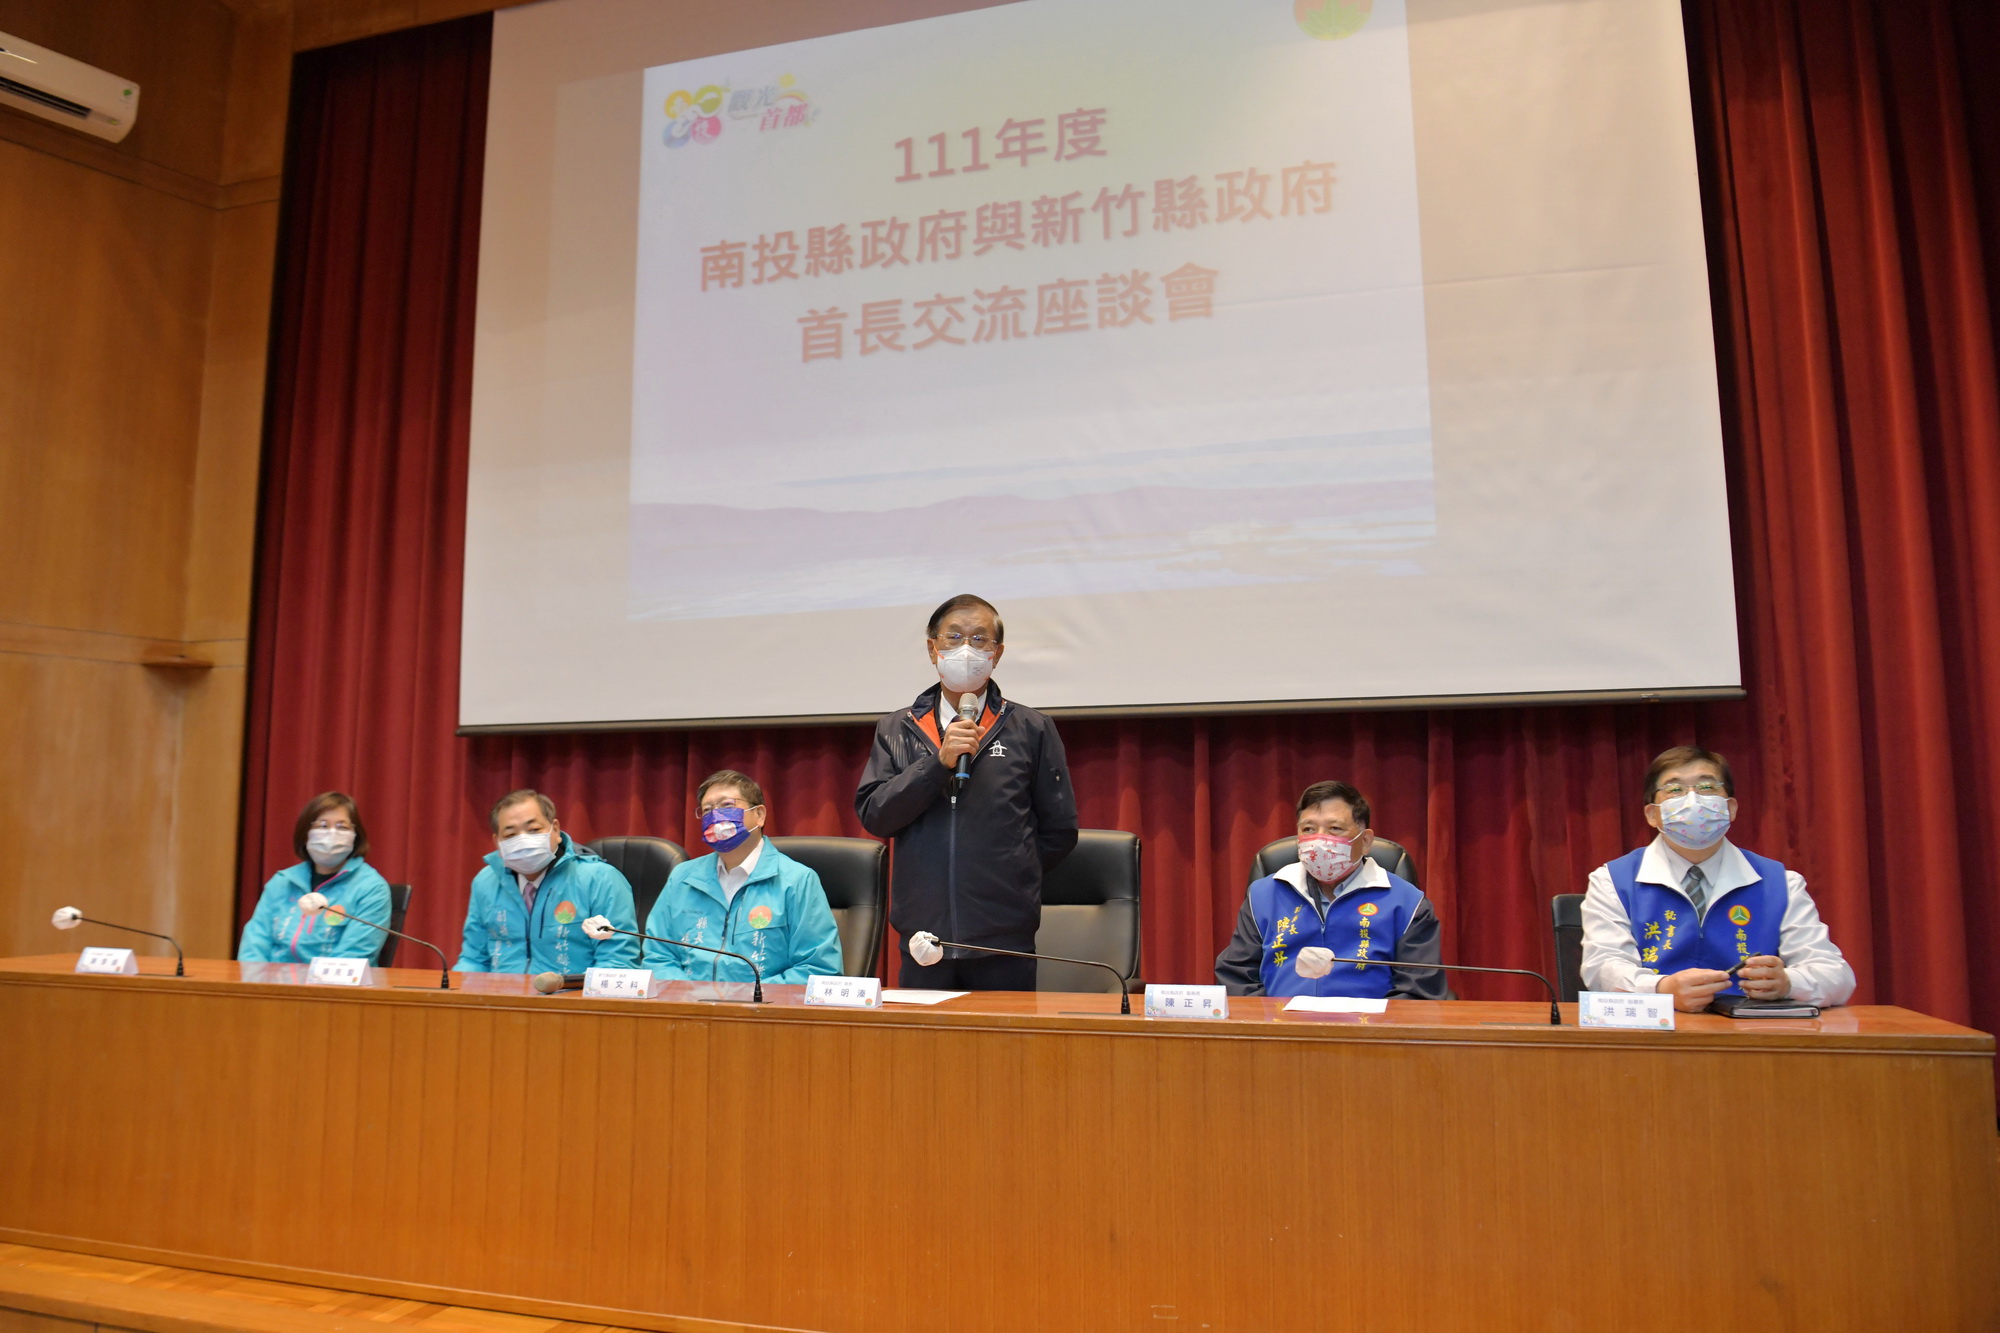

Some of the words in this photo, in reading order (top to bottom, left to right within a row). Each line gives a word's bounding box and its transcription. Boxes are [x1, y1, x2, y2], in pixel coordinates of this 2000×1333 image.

[759, 103, 809, 132] 首都
[894, 106, 1108, 184] 111年度
[700, 159, 1338, 292] 南投縣政府與新竹縣政府
[797, 262, 1219, 364] 首長交流座談會
[601, 979, 639, 989] 楊文科
[1165, 998, 1212, 1008] 陳正昇
[1603, 1005, 1659, 1018] 洪瑞智
